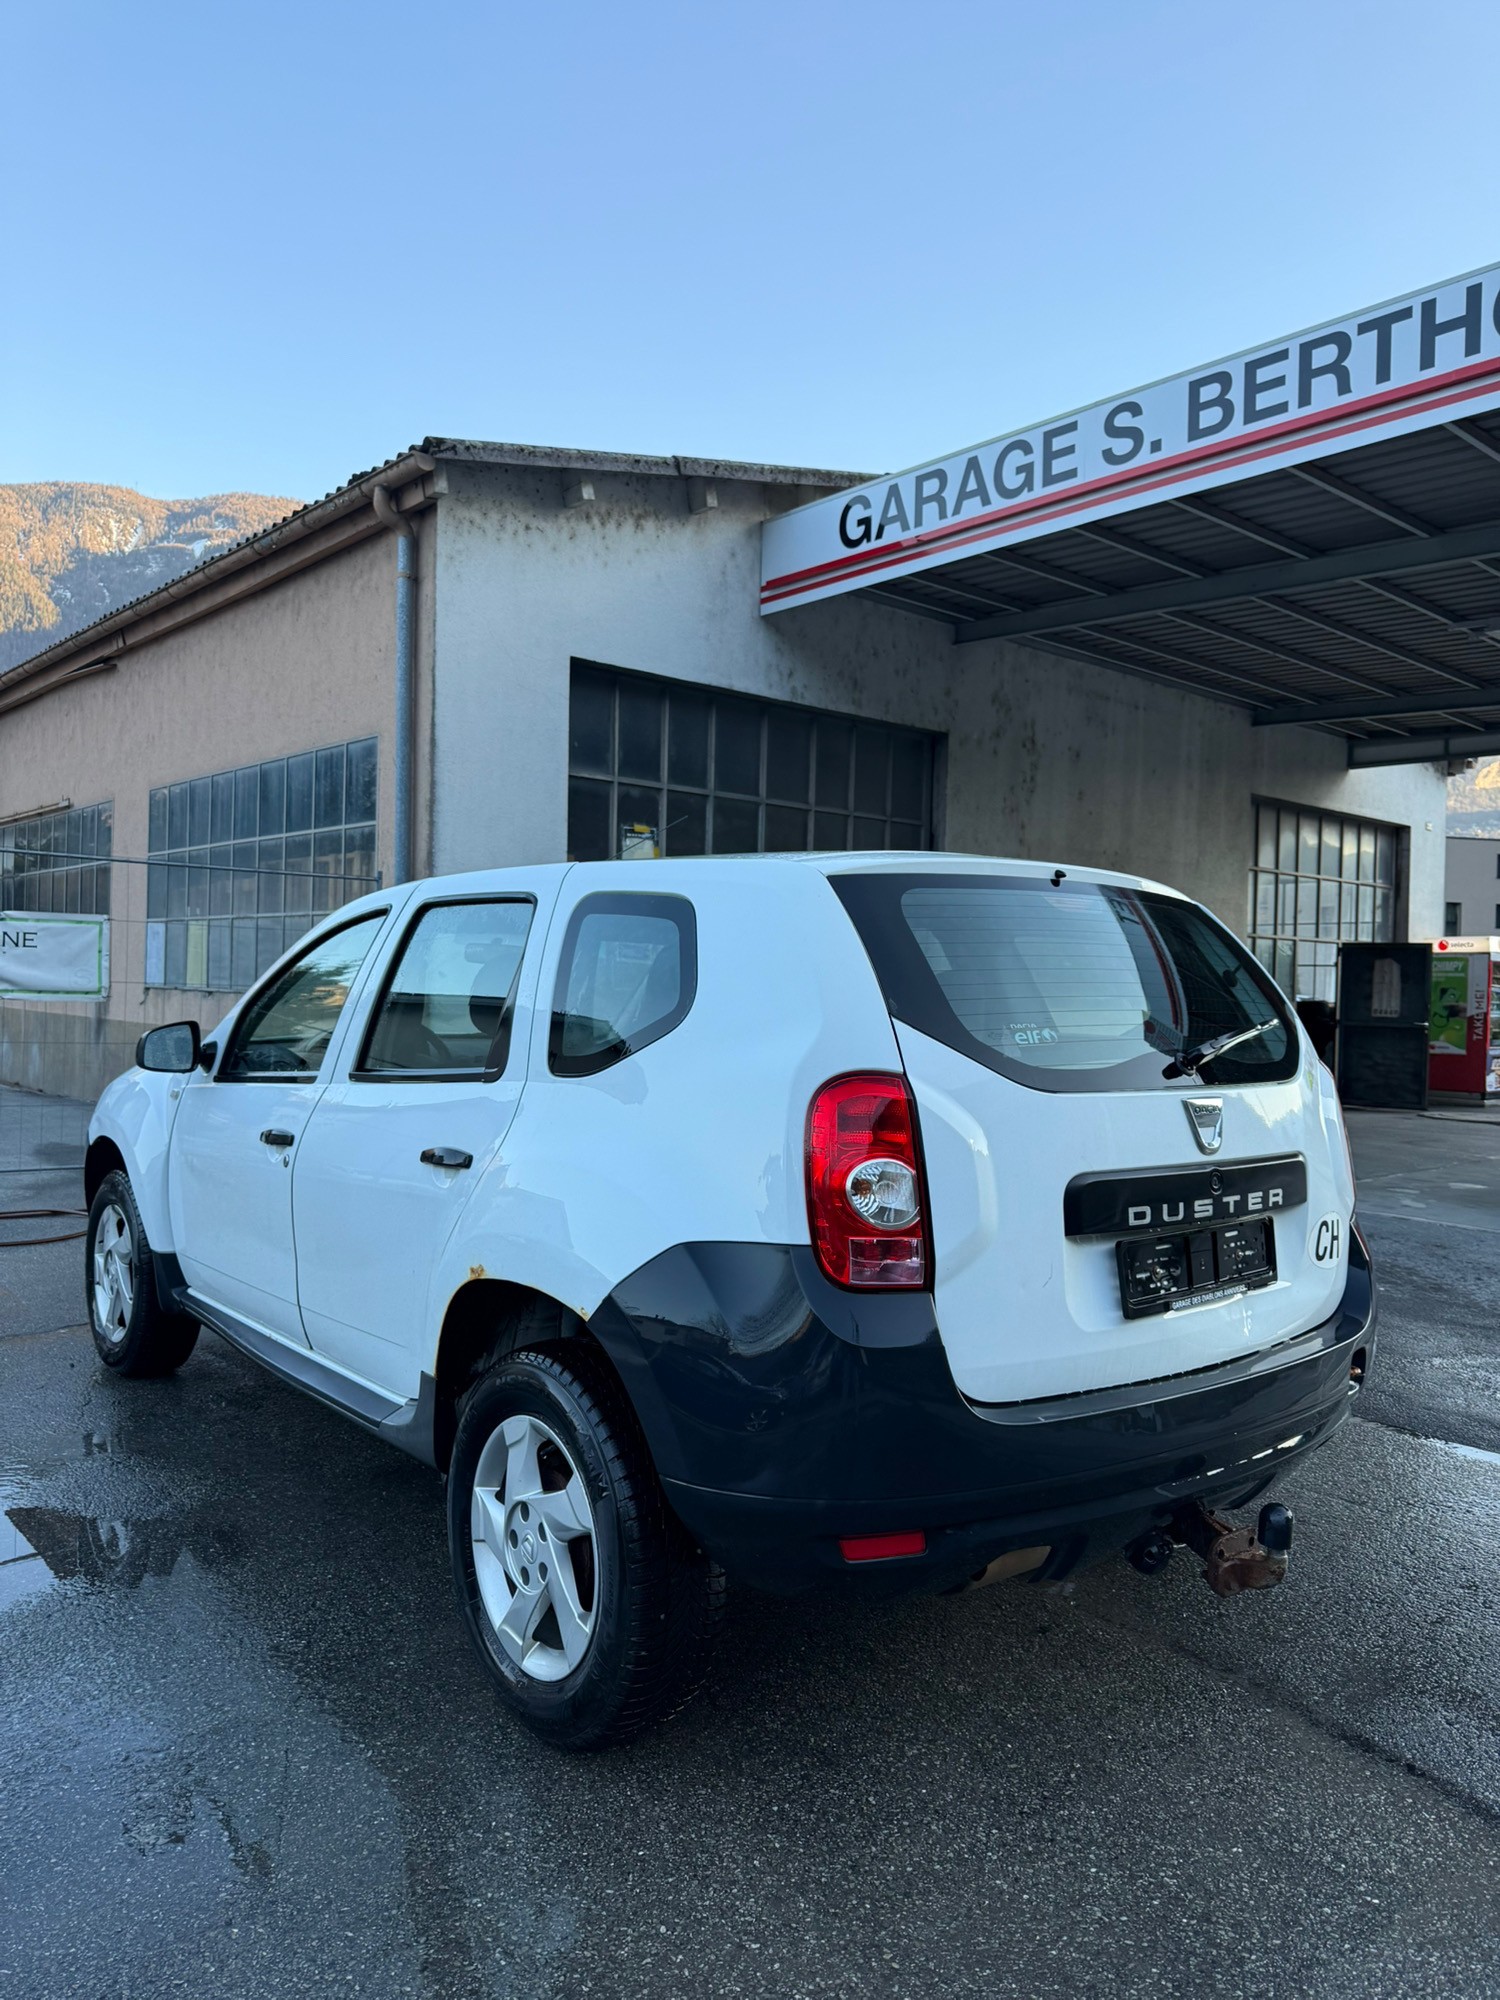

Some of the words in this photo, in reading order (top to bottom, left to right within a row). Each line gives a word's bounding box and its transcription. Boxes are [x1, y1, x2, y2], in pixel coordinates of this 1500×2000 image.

[839, 420, 1078, 548] GARAGE
[1101, 401, 1162, 466] S.
[1187, 282, 1500, 442] BERTH
[1473, 1013, 1484, 1040] TAKE
[1128, 1188, 1283, 1226] DUSTER
[1315, 1219, 1340, 1262] CH
[1172, 1298, 1192, 1309] GARAGE
